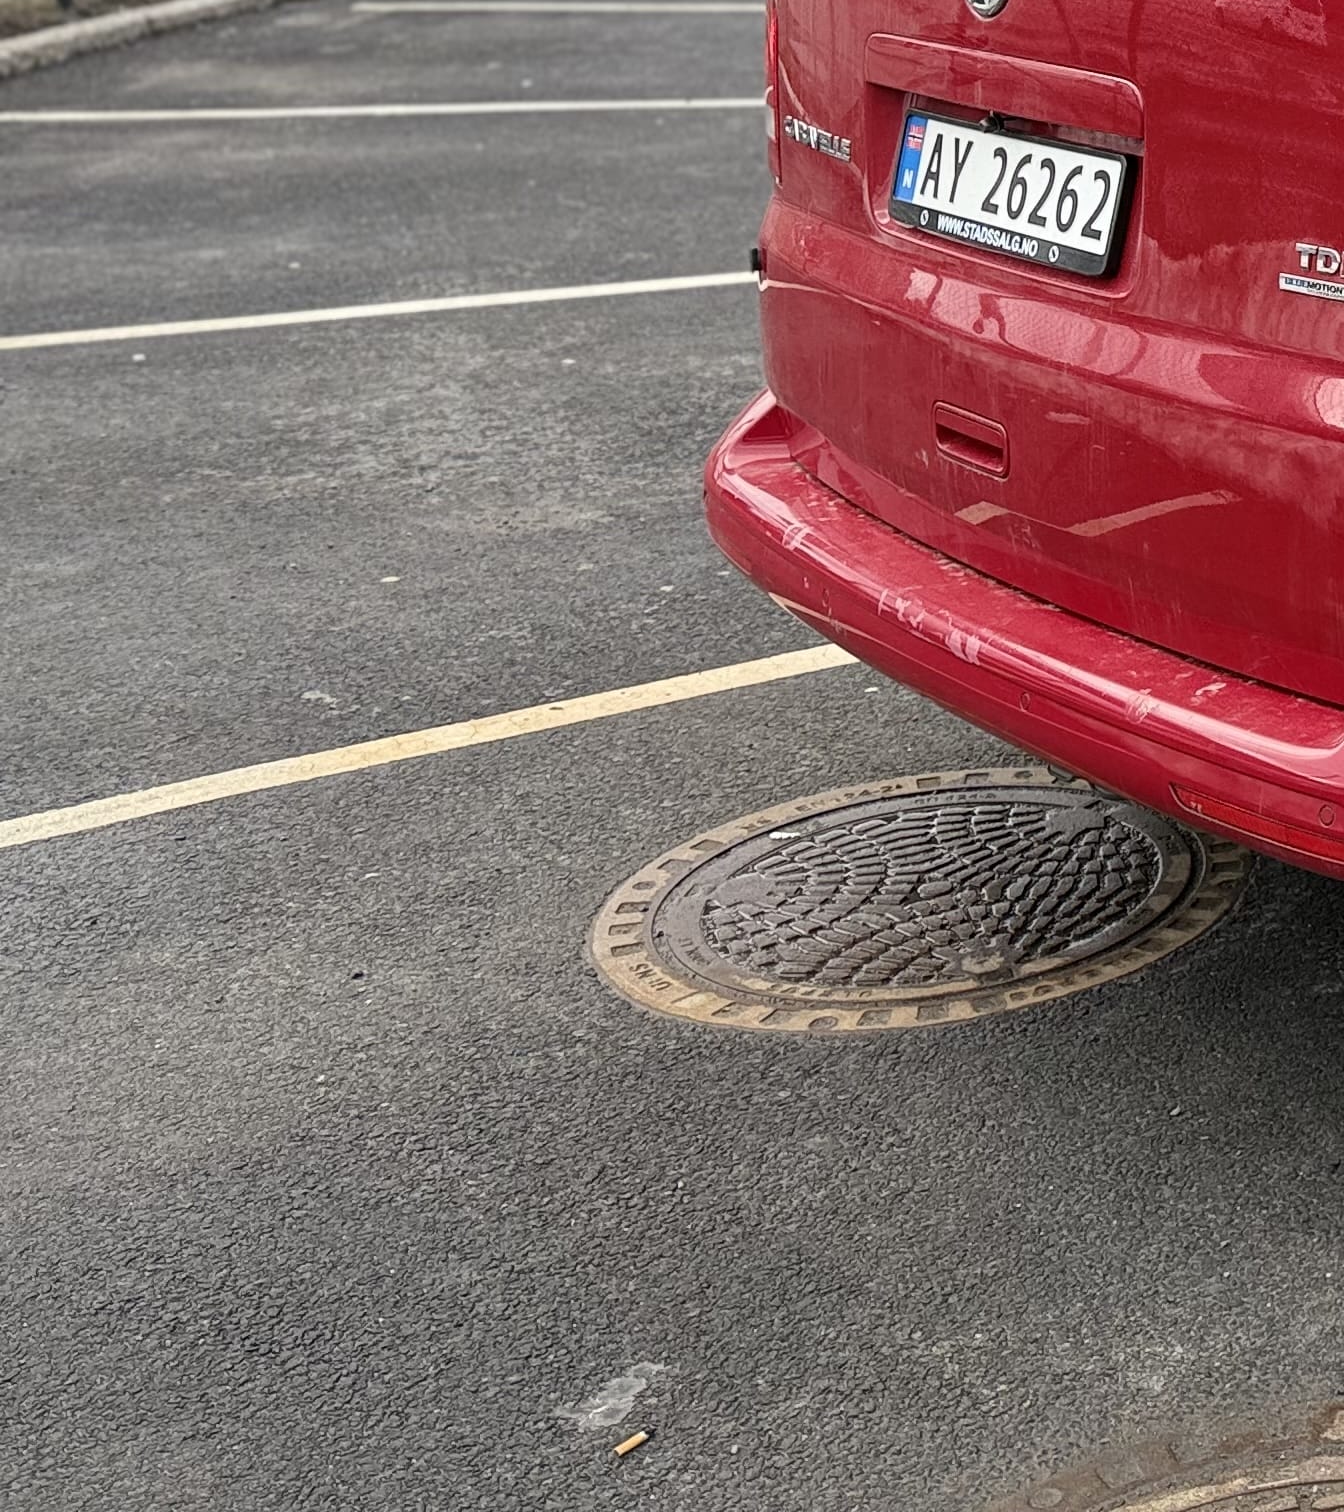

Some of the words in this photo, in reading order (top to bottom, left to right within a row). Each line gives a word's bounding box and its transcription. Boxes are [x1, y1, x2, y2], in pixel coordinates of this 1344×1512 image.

[902, 169, 914, 189] N
[919, 133, 975, 204] AY
[981, 146, 1111, 241] 26262
[936, 213, 1039, 258] WWW.STADSSALG.NO
